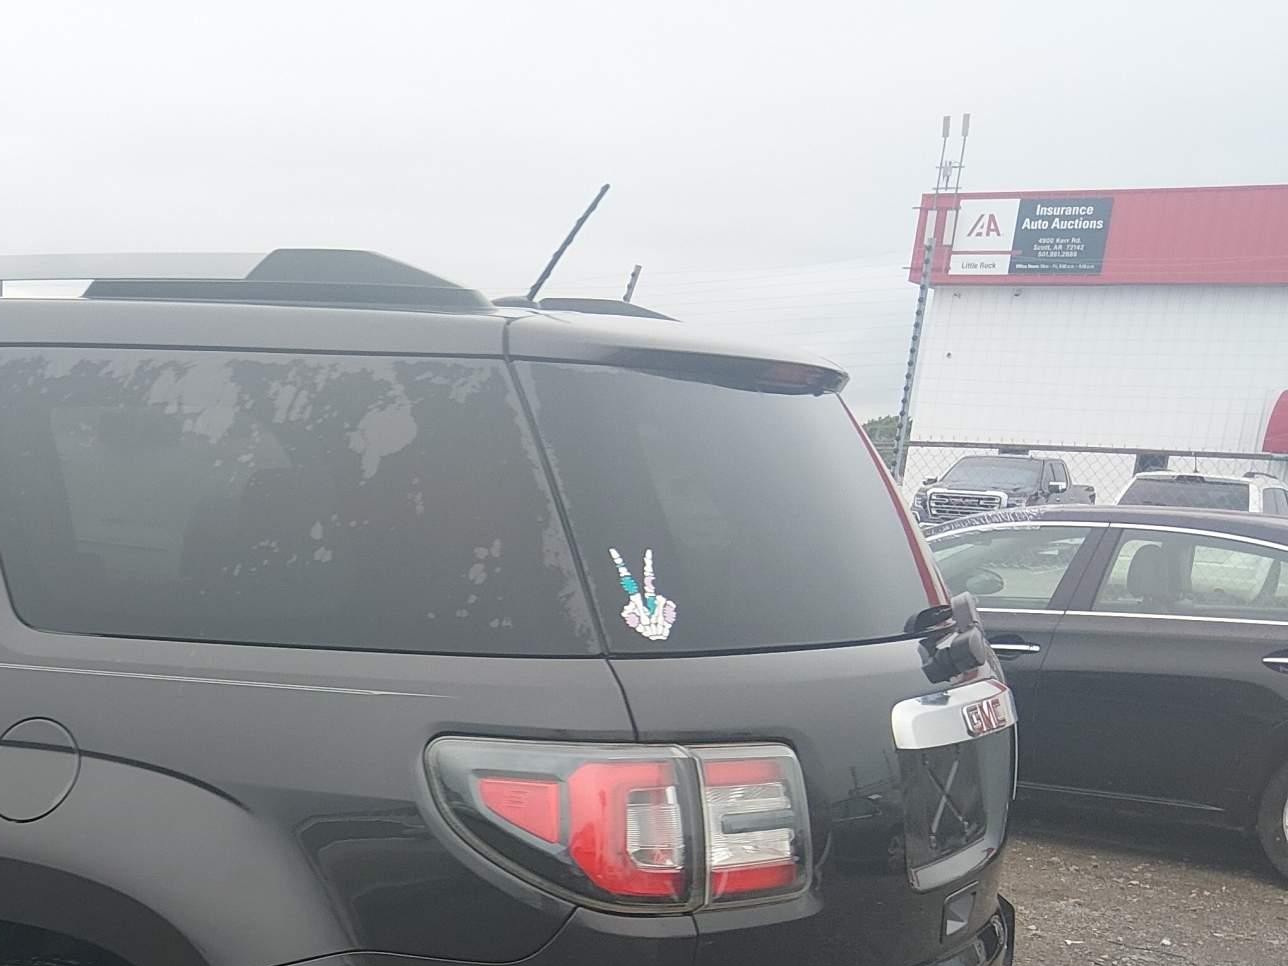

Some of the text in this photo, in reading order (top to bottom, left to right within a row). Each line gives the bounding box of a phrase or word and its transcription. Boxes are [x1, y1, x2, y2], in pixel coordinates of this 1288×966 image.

[1035, 204, 1094, 216] Insurance
[1022, 217, 1104, 230] Auto Auctions
[961, 262, 979, 270] Little
[966, 698, 1007, 733] GMC
